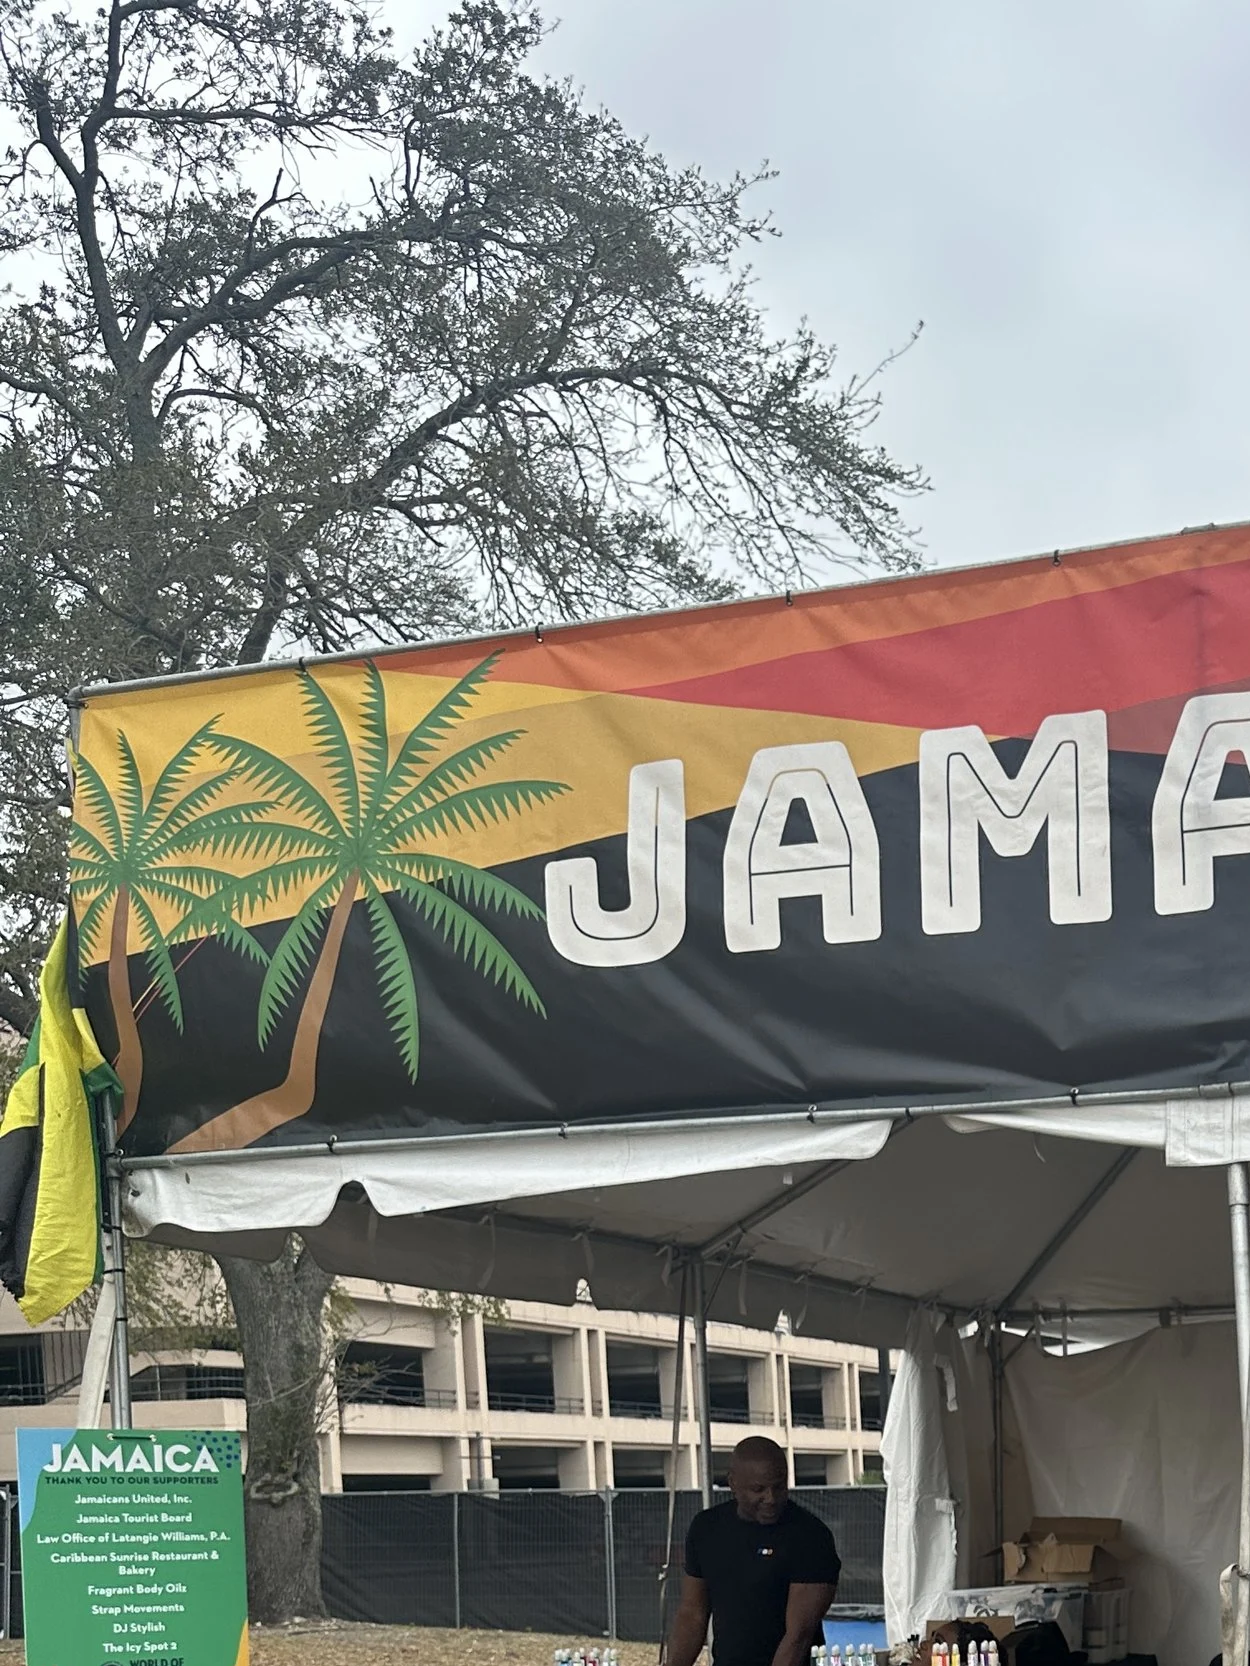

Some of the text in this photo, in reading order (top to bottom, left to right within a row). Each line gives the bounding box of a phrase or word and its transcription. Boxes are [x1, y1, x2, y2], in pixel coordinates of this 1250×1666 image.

[43, 1443, 220, 1473] JAMAICA
[45, 1476, 219, 1485] THANK YOU TO OUR SUPPORTERS
[75, 1493, 193, 1505] Jamaicans United, Inc.
[77, 1512, 192, 1524] Jamaica Tourist Board
[37, 1531, 231, 1545] Law Office of Latangie Williams, P.A.
[50, 1550, 219, 1563] Caribbean Sunrise Restaurant &
[118, 1565, 156, 1576] Bakery
[88, 1585, 134, 1597] Fragrant
[136, 1584, 163, 1596] Body
[91, 1604, 185, 1616] Strap Movements
[113, 1622, 166, 1634] DJ Stylish
[102, 1641, 178, 1654] The Icy Spot 2
